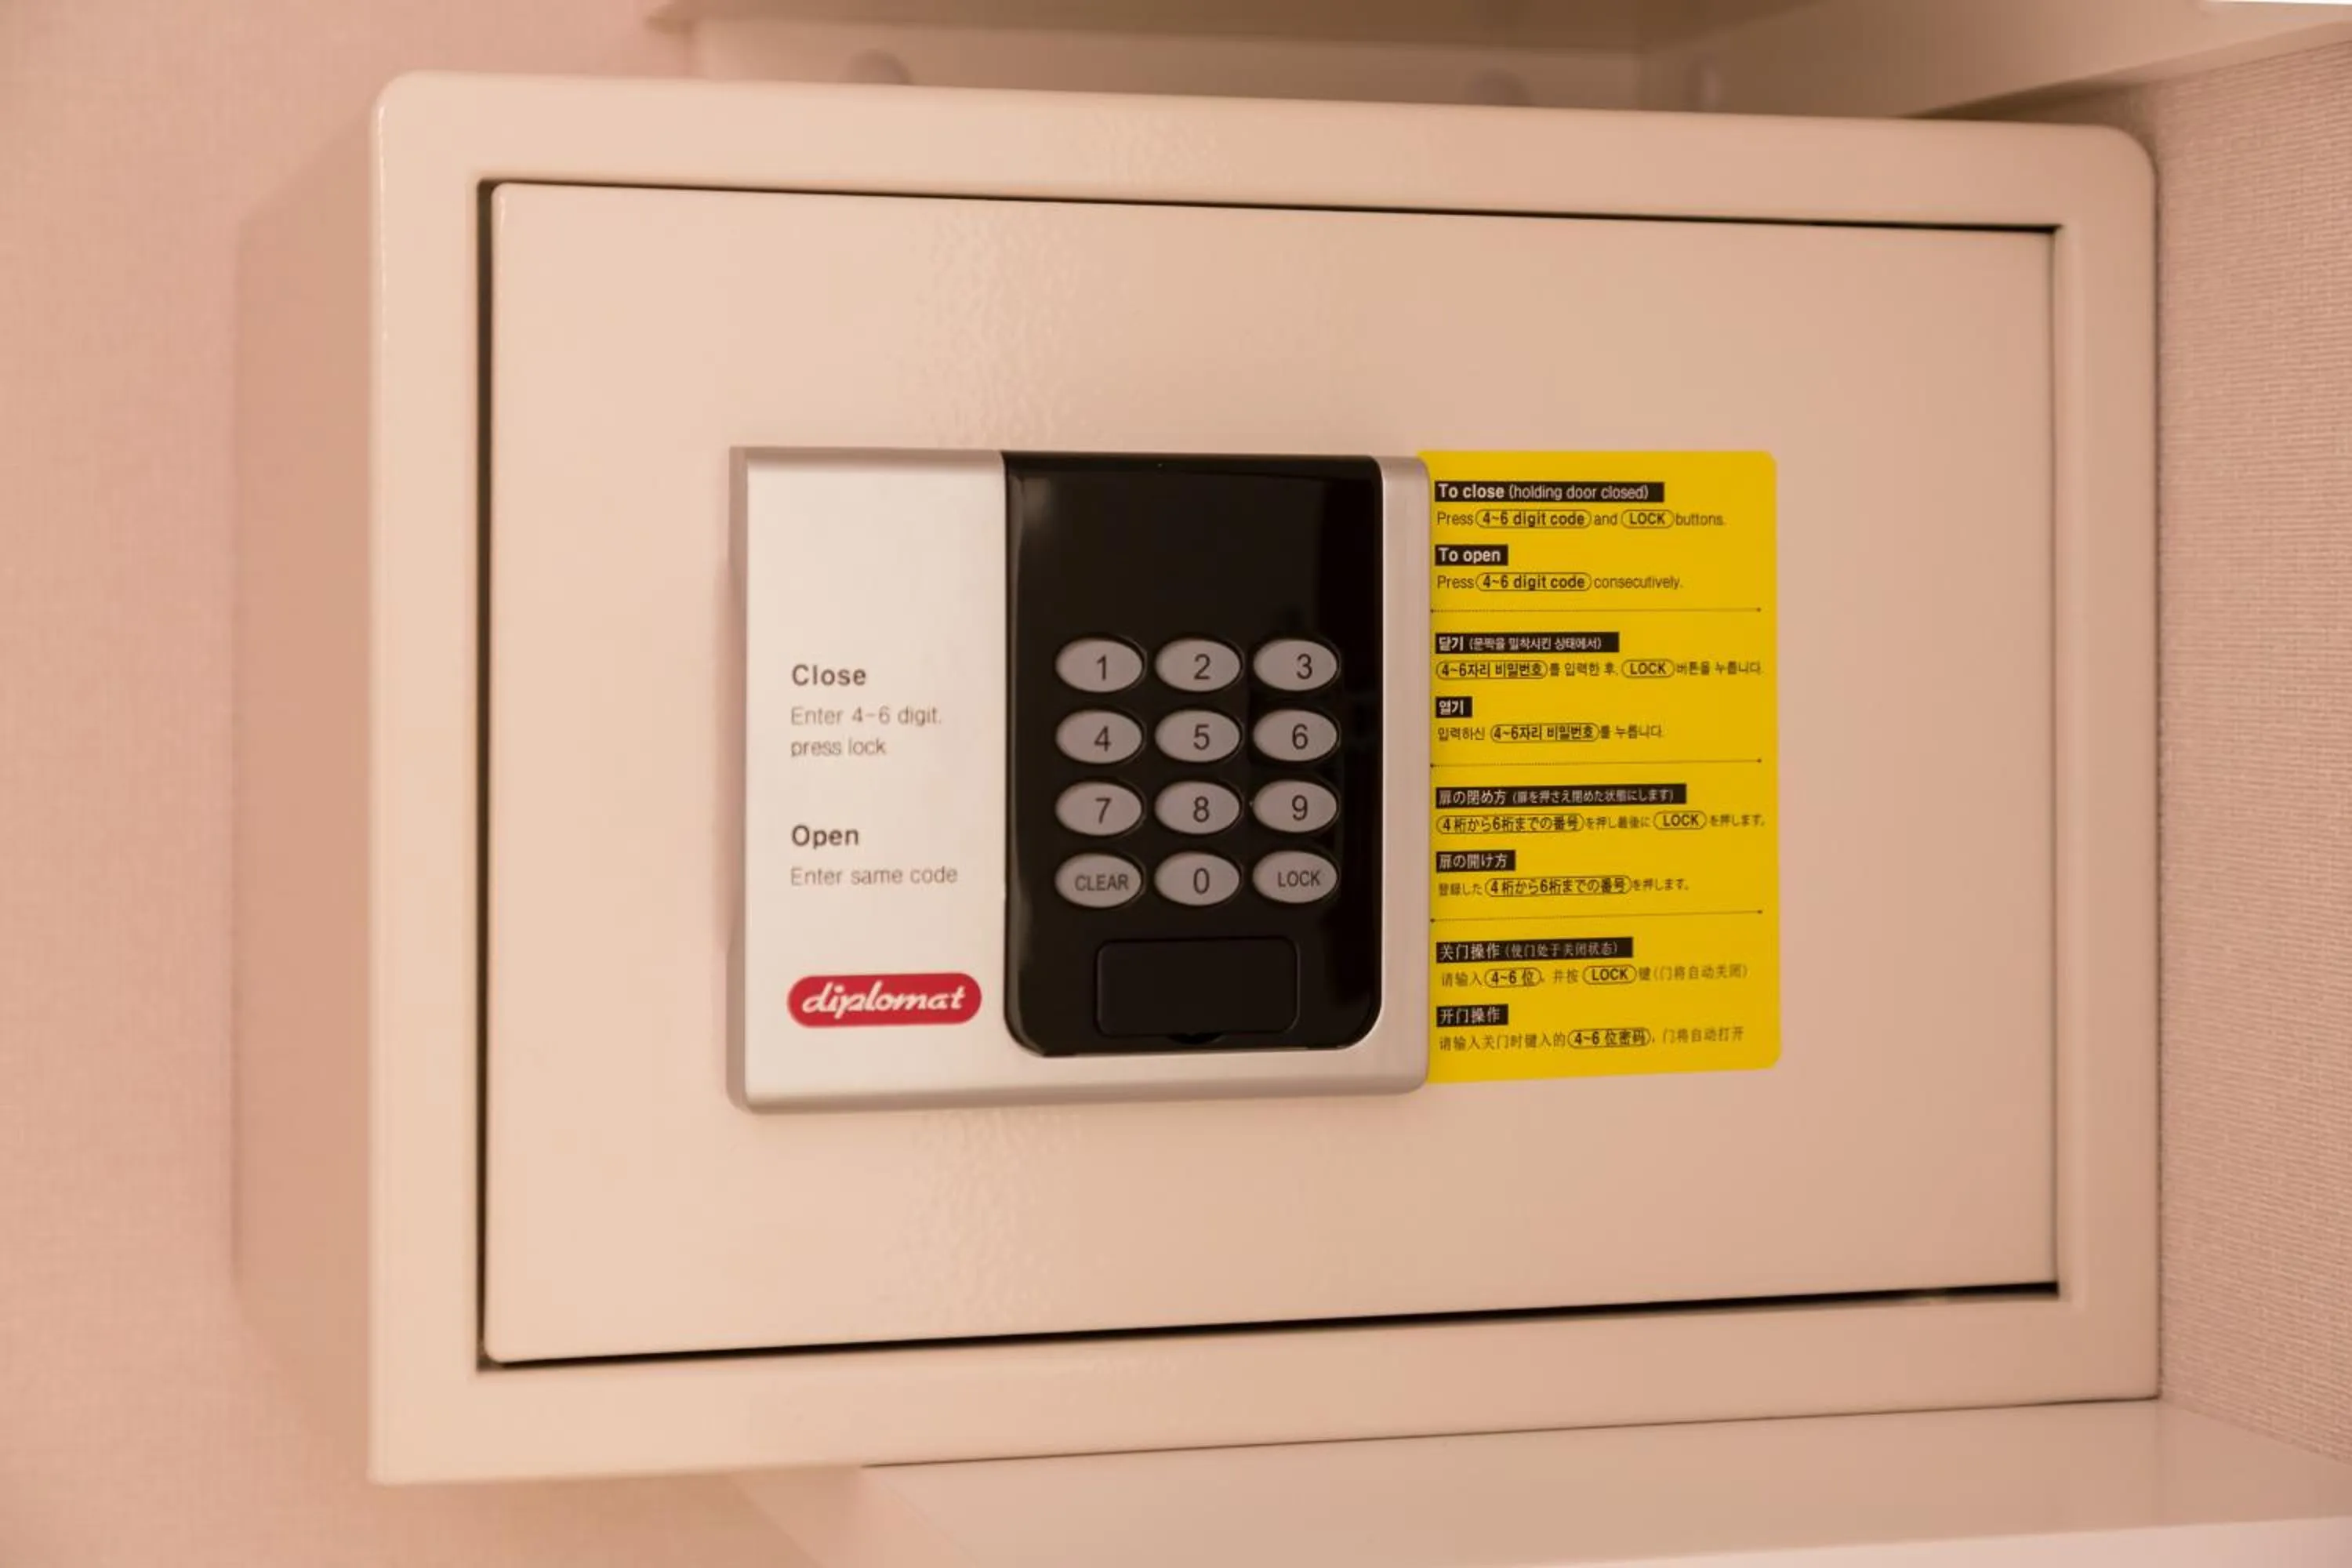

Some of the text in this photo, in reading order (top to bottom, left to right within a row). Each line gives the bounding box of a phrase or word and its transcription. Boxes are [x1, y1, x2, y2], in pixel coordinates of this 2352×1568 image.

[1439, 484, 1649, 502] To close (holding door closed)
[1437, 511, 1474, 525] Press
[1482, 512, 1509, 525] 4~6
[1513, 511, 1548, 528] digit
[1550, 512, 1585, 525] code
[1594, 513, 1618, 526] and
[1628, 512, 1666, 525] LOCK
[1439, 547, 1501, 566] To open
[1437, 575, 1684, 592] Press 4~6 digit code consecutively.
[791, 664, 867, 686] Close
[1096, 652, 1313, 681] 1 2 3
[1564, 662, 1601, 677] 입력한
[1629, 662, 1667, 676] LOCK
[790, 706, 844, 726] Enter
[1438, 699, 1465, 715] 열기
[790, 737, 887, 757] press lock
[1093, 723, 1309, 753] 4 5 6
[1095, 793, 1308, 824] 7 8 9
[1662, 813, 1700, 827] LOCK
[791, 824, 860, 849] Open
[1439, 853, 1508, 869] 扉の開け方
[790, 866, 958, 886] Enter same code
[1074, 867, 1322, 895] CLEAR 0 LOCK
[1439, 942, 1501, 960] 关门操作
[1592, 967, 1629, 982] LOCK
[800, 980, 965, 1020] diplomat
[1439, 1007, 1501, 1024] 开门操作
